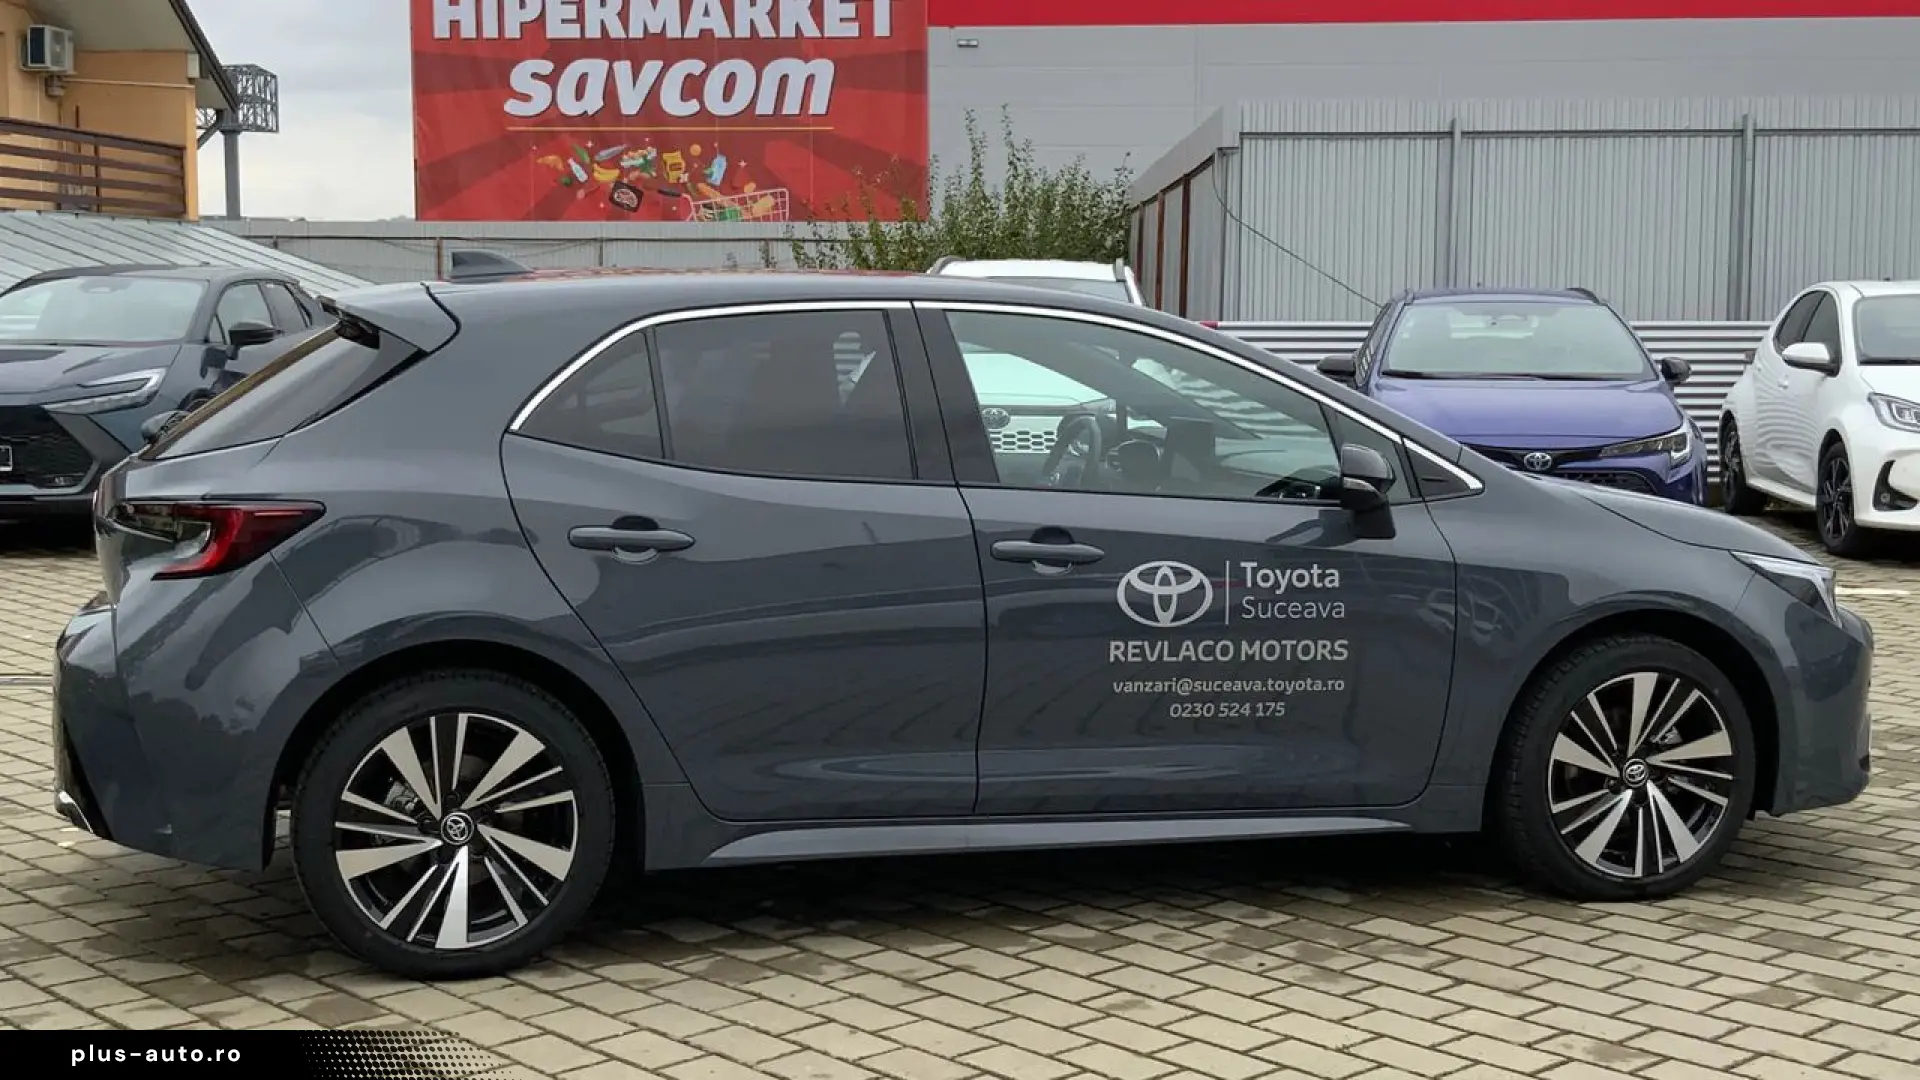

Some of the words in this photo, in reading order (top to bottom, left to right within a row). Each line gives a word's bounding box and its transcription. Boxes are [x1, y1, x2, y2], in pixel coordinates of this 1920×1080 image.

[433, 0, 893, 39] HIPERMARKET
[504, 58, 835, 117] savcom
[1240, 561, 1340, 595] Toyota
[1241, 596, 1346, 619] Suceava
[1108, 640, 1235, 663] REVLACO
[1240, 639, 1349, 662] MOTORS
[1112, 677, 1345, 696] vanzari@suceava.toyota.ro
[1169, 702, 1215, 718] 0230
[1217, 702, 1251, 718] 524
[1255, 702, 1286, 717] 175
